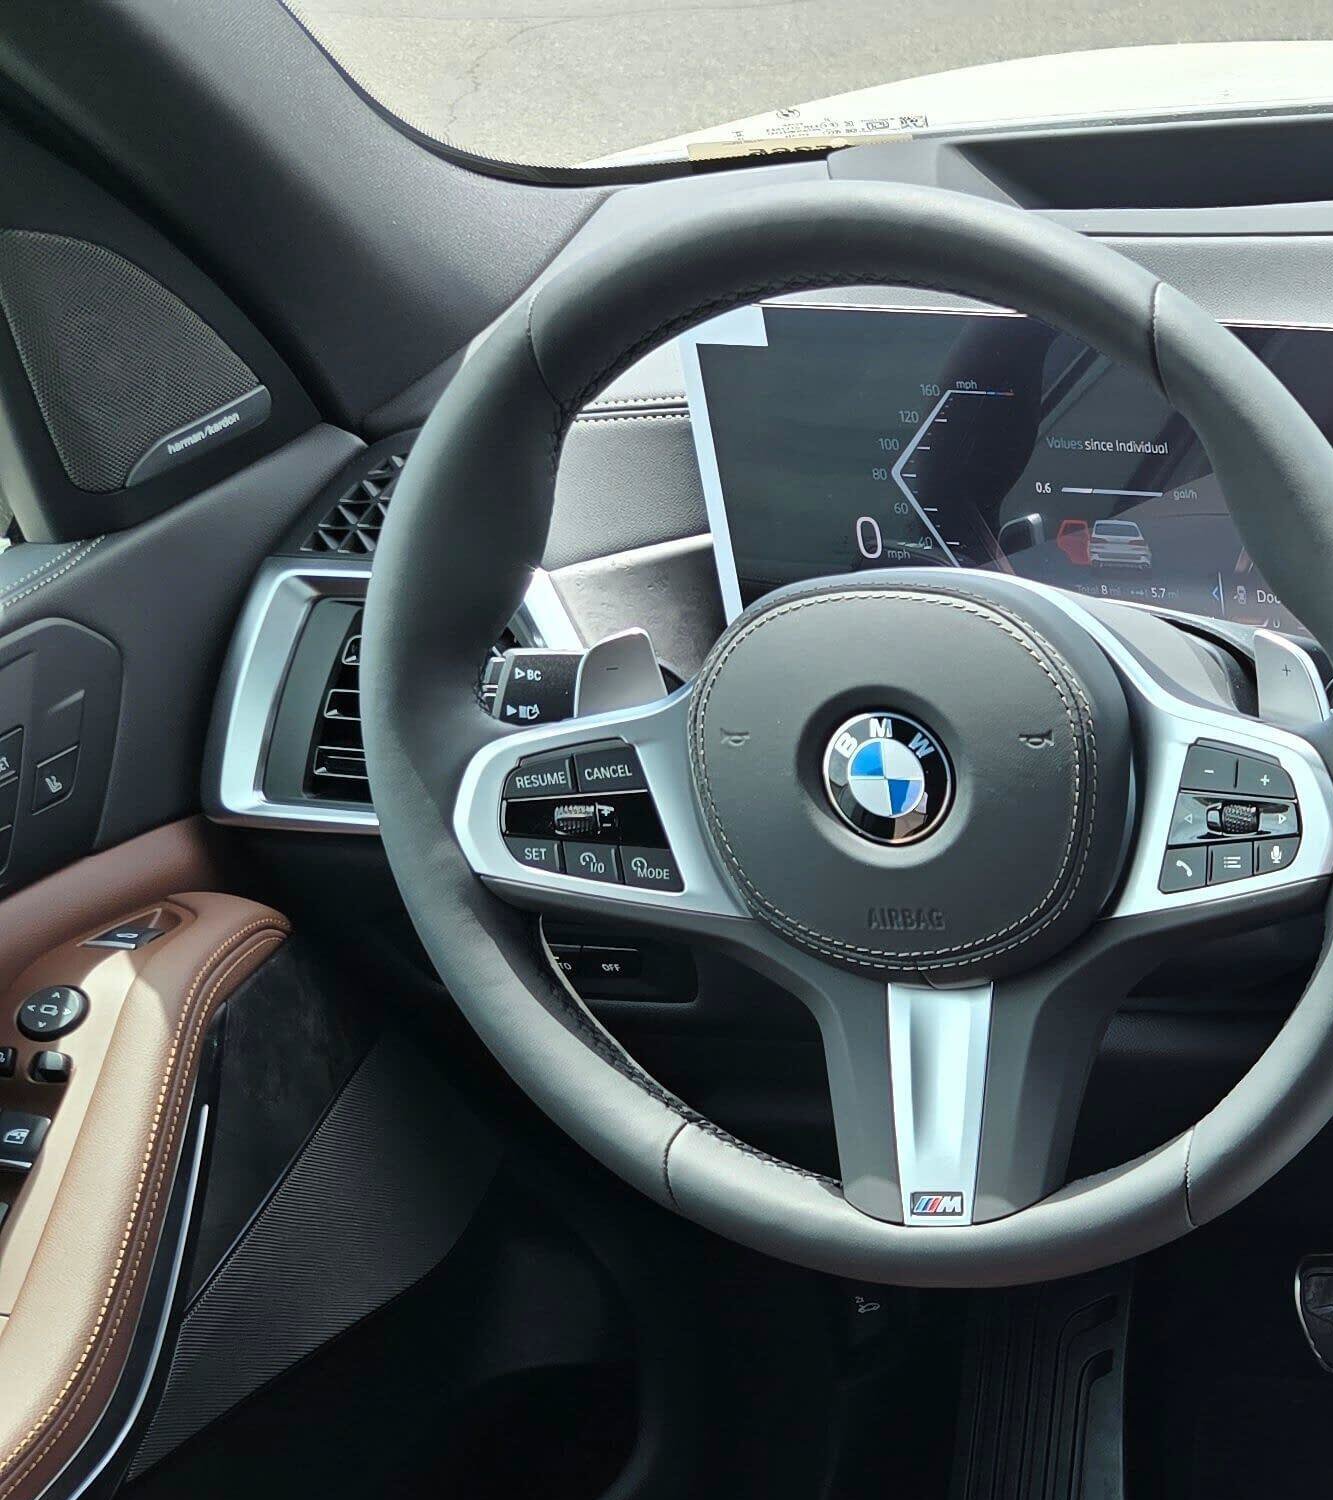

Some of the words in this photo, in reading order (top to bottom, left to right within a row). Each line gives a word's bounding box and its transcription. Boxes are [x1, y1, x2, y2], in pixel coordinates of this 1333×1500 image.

[920, 384, 940, 397] 160
[956, 379, 978, 390] mph
[899, 411, 919, 423] 120
[167, 411, 240, 455] harman/kardon
[878, 438, 899, 451] 100
[1046, 437, 1084, 450] Values
[1085, 439, 1114, 452] since
[1116, 440, 1169, 455] Individual
[872, 468, 887, 480] 80
[1035, 482, 1051, 494] 0.6
[1173, 489, 1198, 501] gal/h
[894, 503, 908, 514] 60
[856, 516, 882, 559] 0
[919, 537, 933, 549] 40
[887, 549, 911, 560] mph
[1101, 585, 1108, 595] 8
[1151, 587, 1166, 598] 5.7
[527, 669, 542, 682] BC
[834, 718, 935, 760] BMW
[584, 764, 633, 781] CANCEL
[515, 771, 567, 789] RESUME
[524, 848, 547, 861] SET
[637, 866, 670, 880] MODE
[867, 907, 946, 931] AIRBAG
[601, 963, 621, 972] OFF
